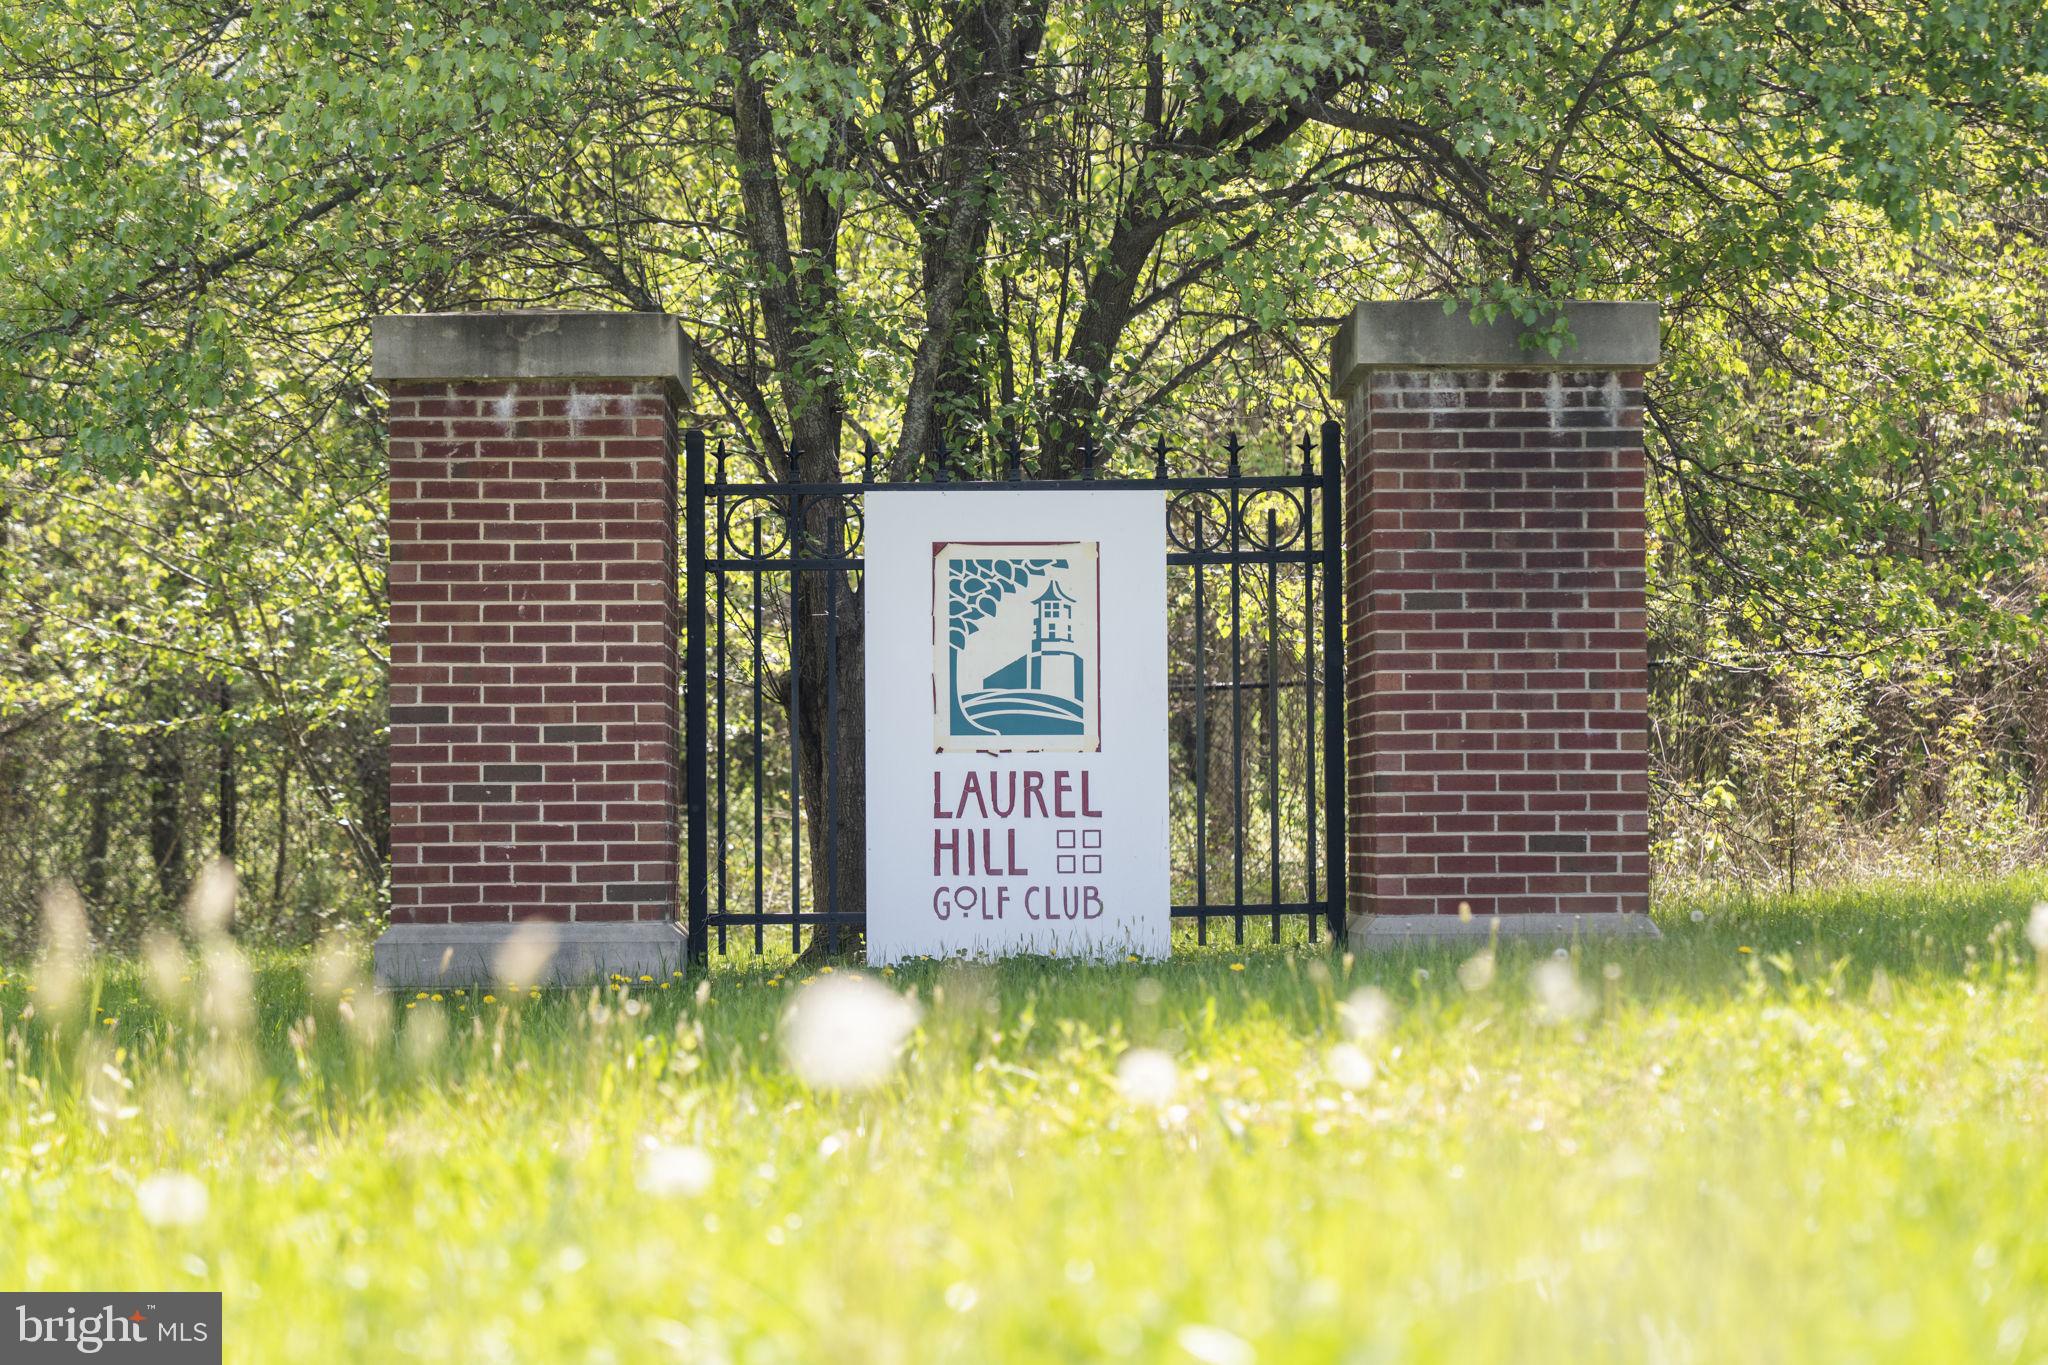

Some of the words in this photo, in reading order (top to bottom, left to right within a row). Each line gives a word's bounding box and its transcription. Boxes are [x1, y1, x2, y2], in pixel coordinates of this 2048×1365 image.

[933, 770, 1102, 819] LAUREL
[933, 828, 1028, 876] HILL
[933, 886, 1010, 920] GOLF
[1024, 886, 1103, 920] CLUB
